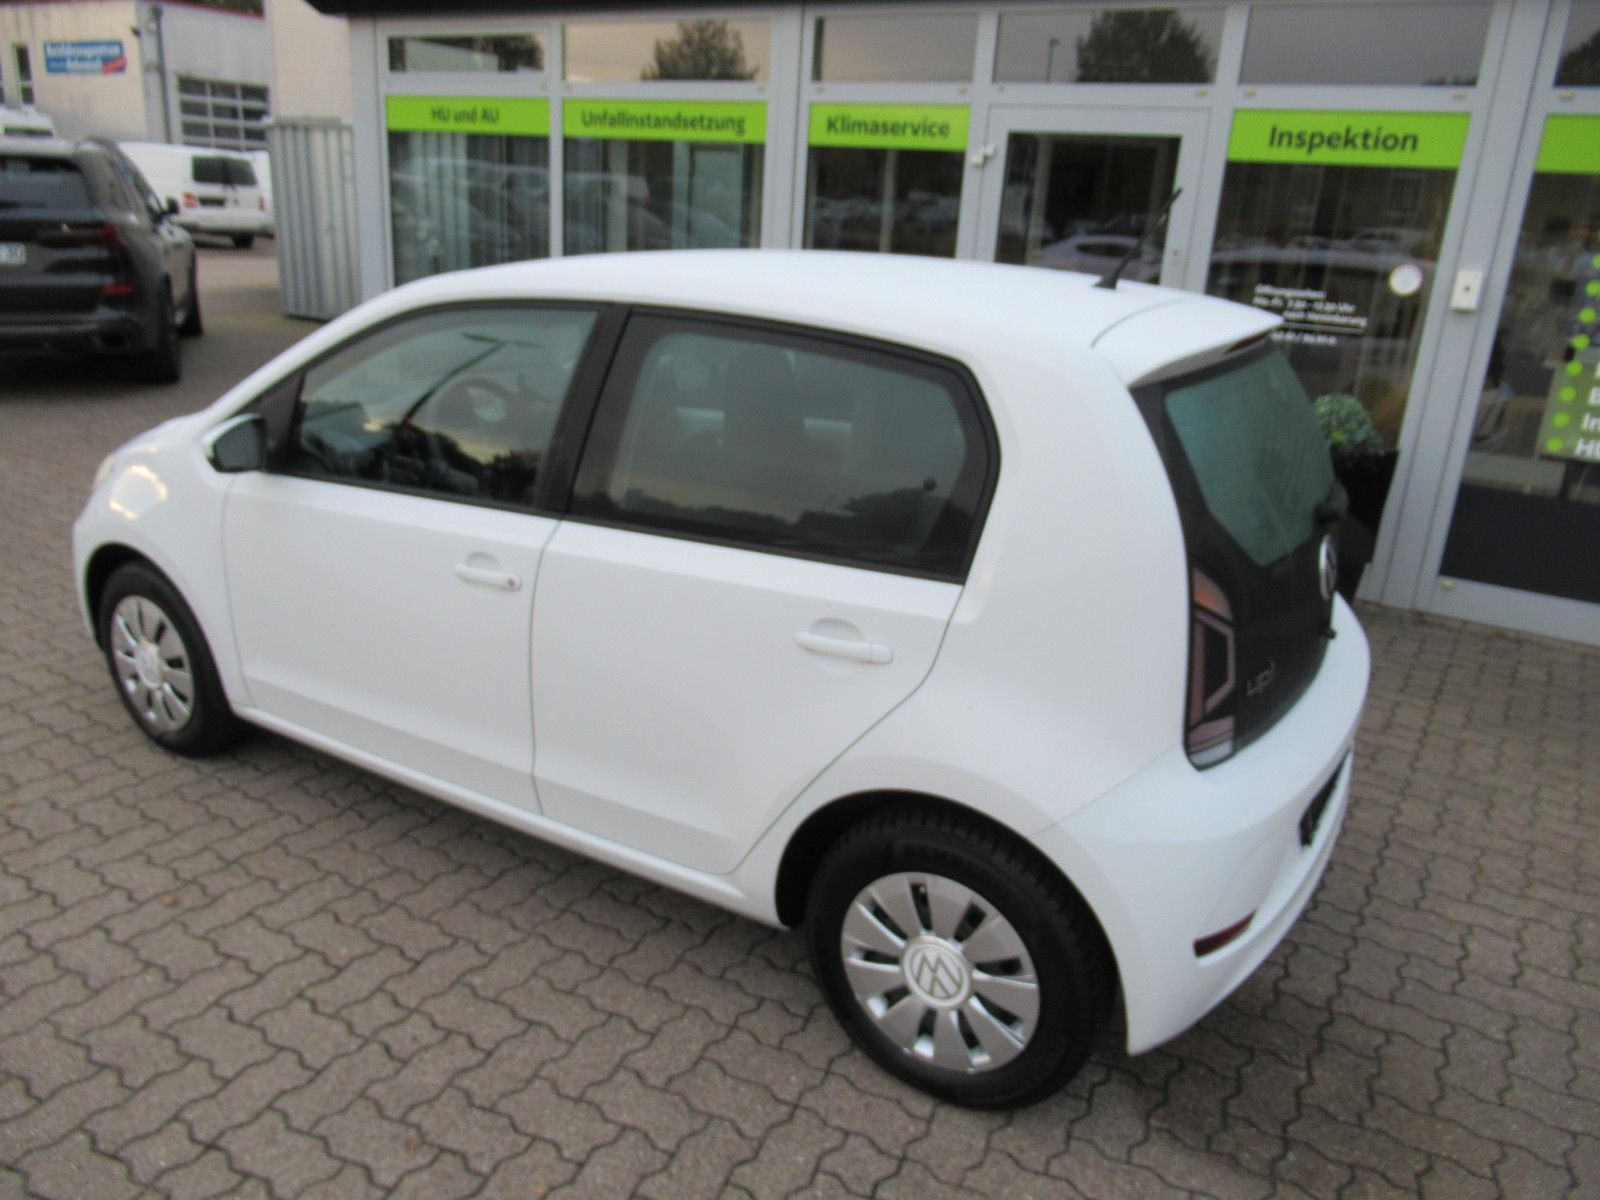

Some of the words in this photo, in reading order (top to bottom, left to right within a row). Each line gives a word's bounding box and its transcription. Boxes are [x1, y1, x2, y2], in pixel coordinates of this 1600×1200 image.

[432, 106, 450, 122] HU
[454, 105, 478, 123] und
[482, 107, 499, 123] AU
[582, 107, 745, 137] Unfallinstandsetzung
[827, 114, 950, 140] Klimaservice
[1269, 124, 1419, 154] Inspektion
